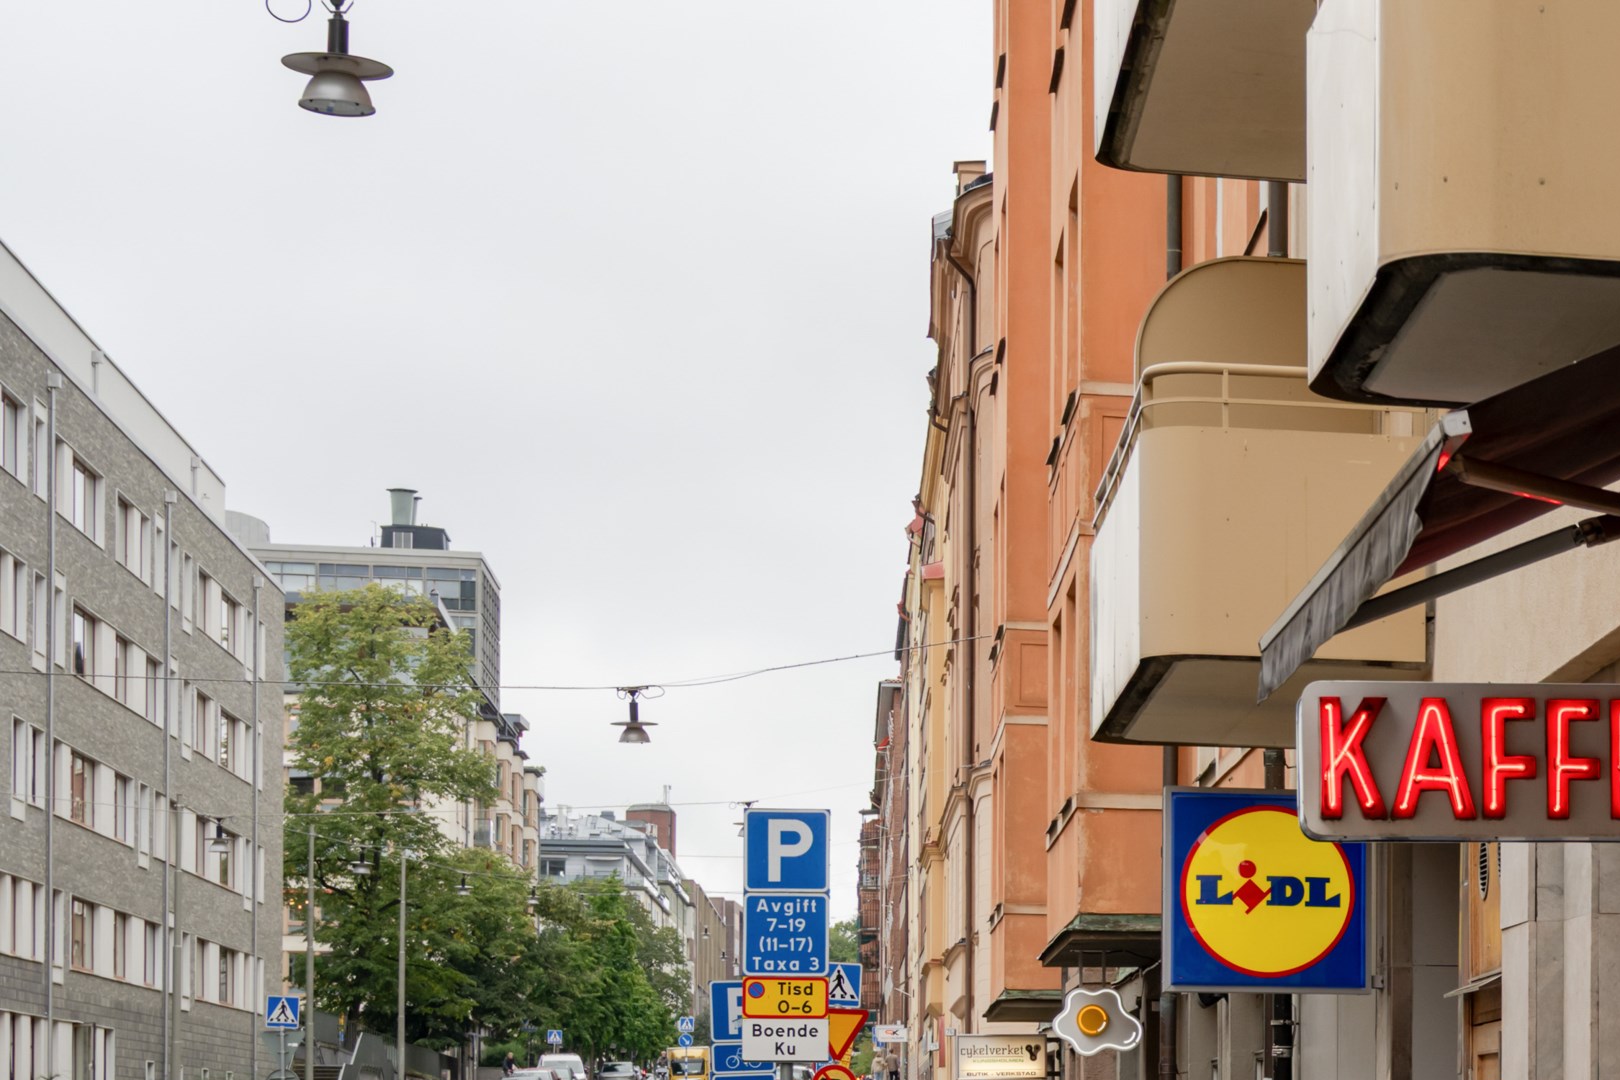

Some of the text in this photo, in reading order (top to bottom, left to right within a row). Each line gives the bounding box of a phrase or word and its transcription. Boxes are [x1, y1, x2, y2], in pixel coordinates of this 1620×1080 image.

[767, 818, 814, 882] P
[756, 898, 817, 916] Avgift
[766, 918, 806, 932] 7-19
[758, 936, 813, 953] (11-17)
[752, 957, 819, 971] Taxa 3
[777, 982, 814, 996] Tisd
[777, 1000, 812, 1014] 0-6
[752, 1023, 819, 1038] Boende
[775, 1042, 796, 1056] Ku
[960, 1044, 1024, 1058] cykelverket
